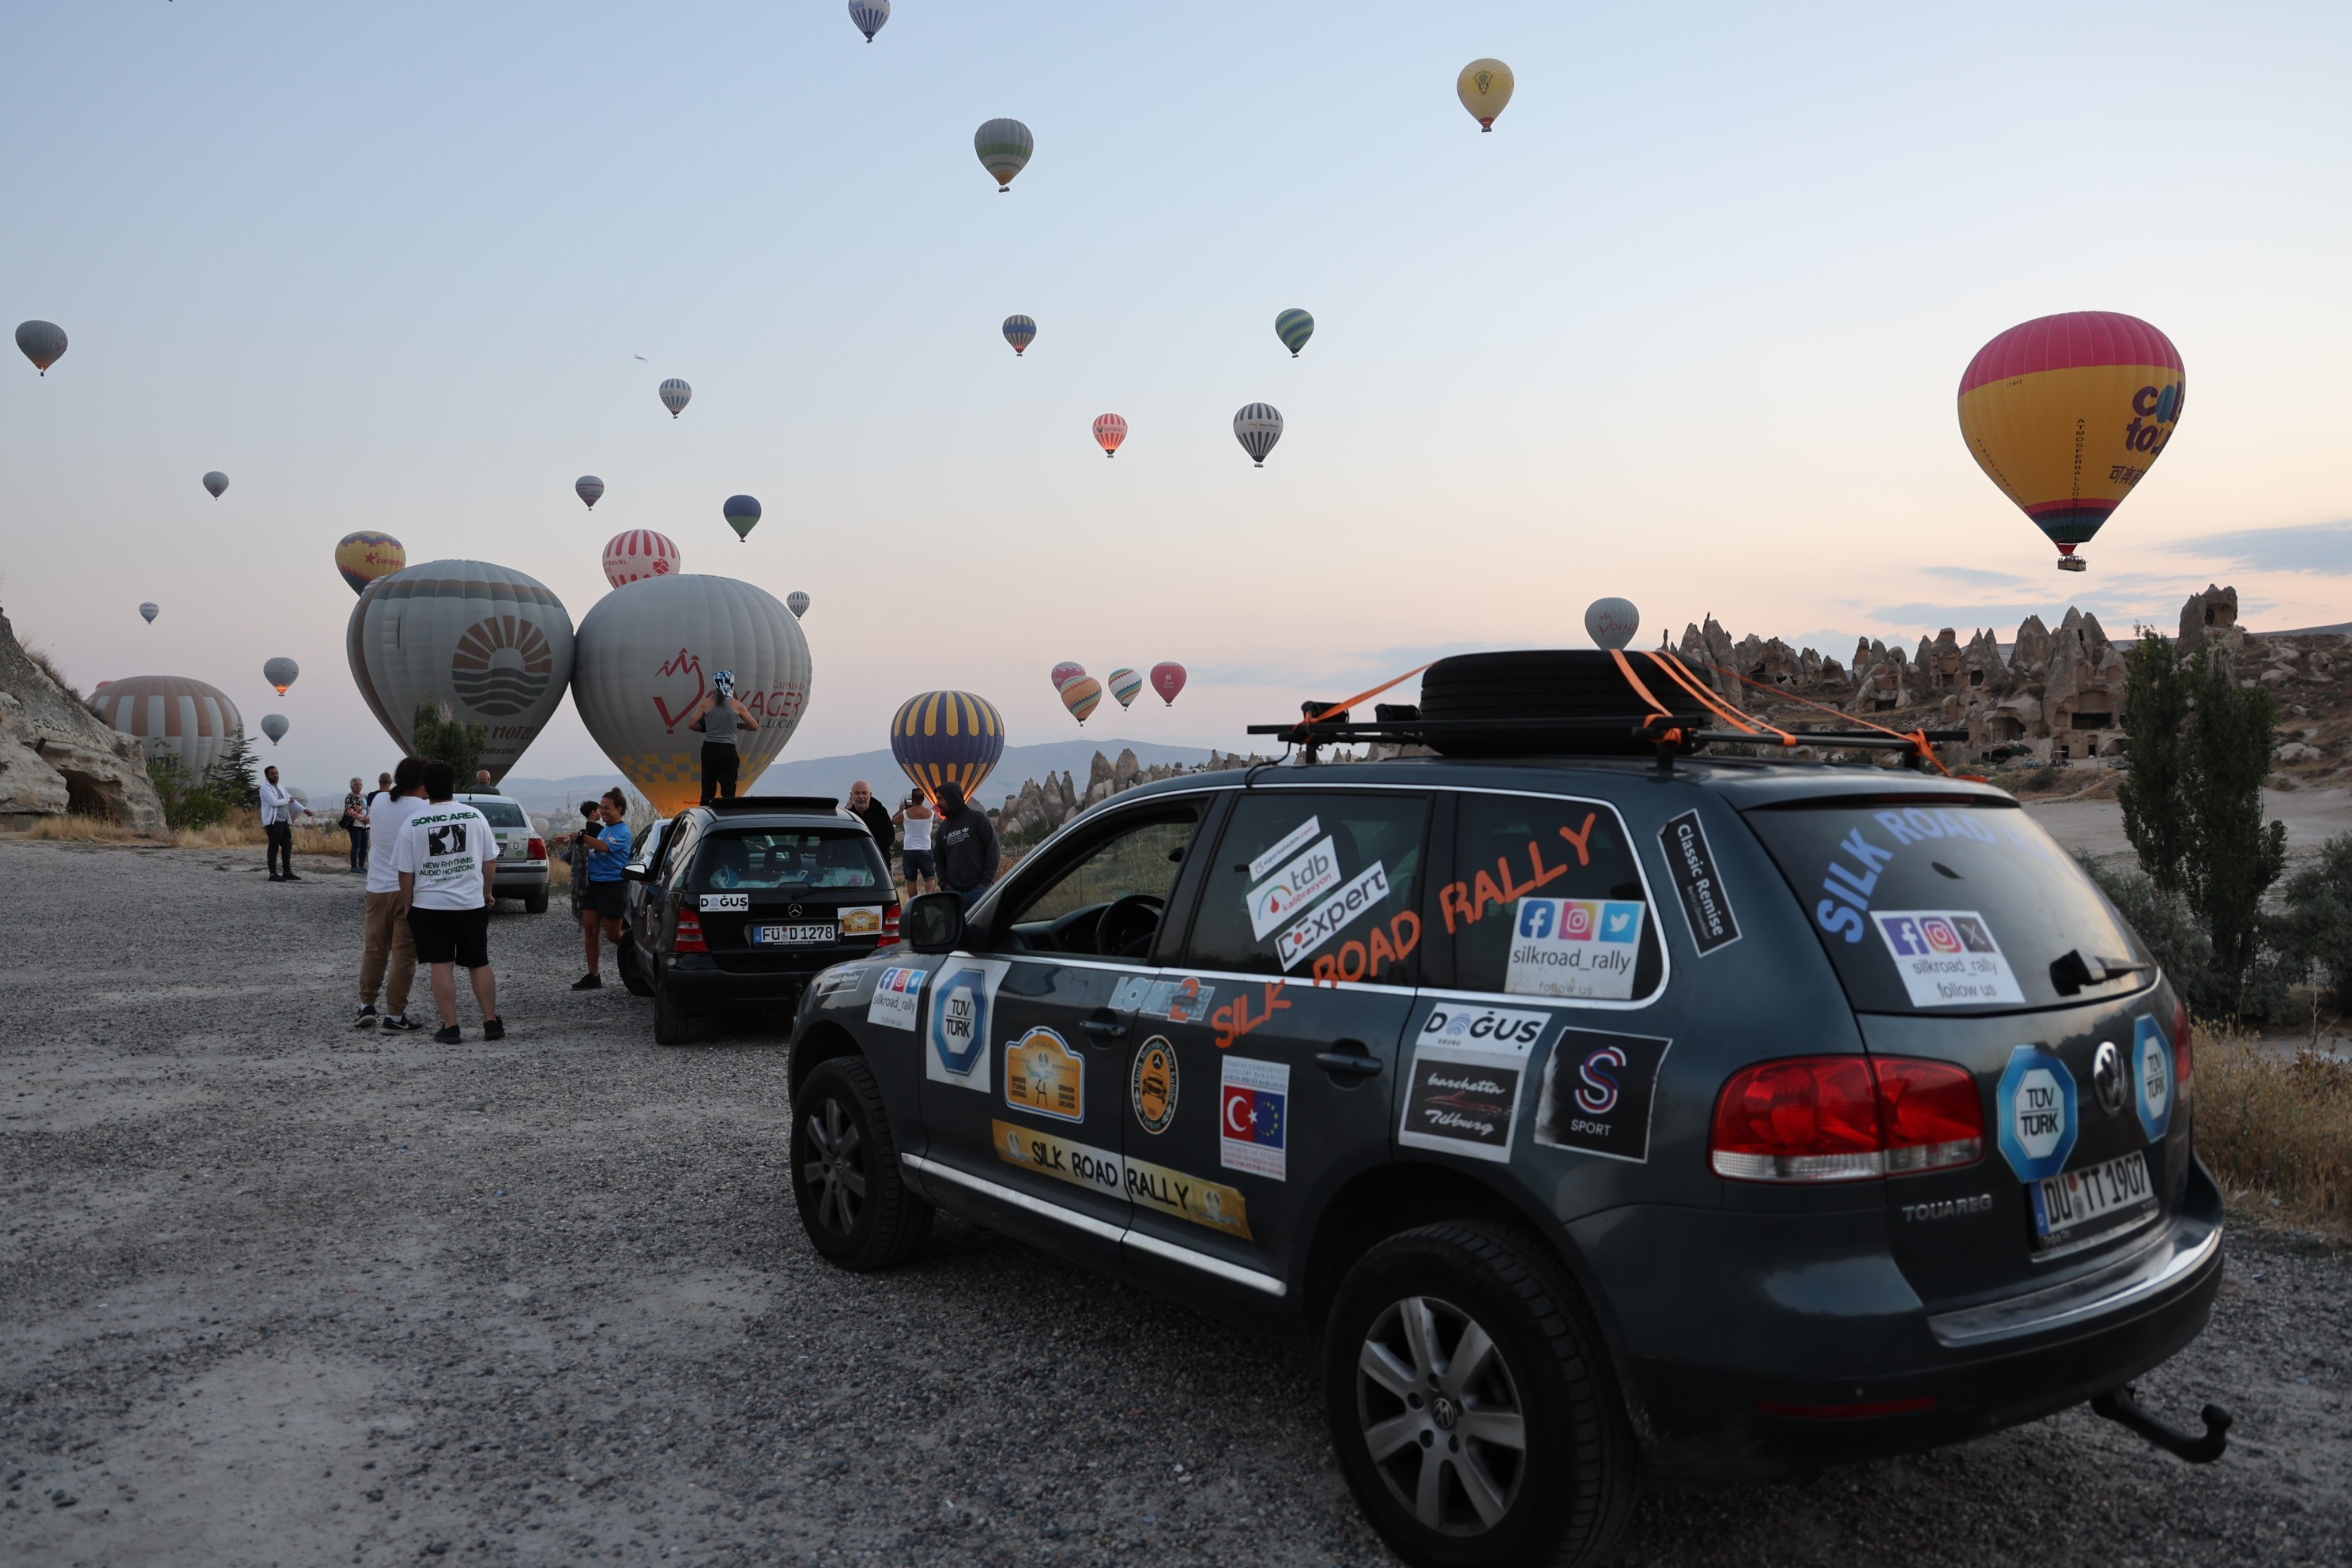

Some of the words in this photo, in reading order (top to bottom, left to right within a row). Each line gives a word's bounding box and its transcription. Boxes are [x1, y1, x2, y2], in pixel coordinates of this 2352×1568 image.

[412, 815, 447, 827] SONIC
[450, 812, 479, 821] AREA
[441, 857, 473, 868] RHYTHMS
[442, 864, 476, 876] HORIZONS
[1291, 854, 1329, 891] tdb
[1677, 823, 1704, 878] Classic
[1695, 877, 1724, 937] Remise
[1817, 827, 1894, 944] SILK
[1873, 806, 1997, 846] ROAD
[1282, 873, 1332, 912] kalibrasyon
[763, 928, 780, 940] FÜ
[789, 927, 797, 940] D
[801, 926, 833, 940] 1278
[1212, 979, 1292, 1048] SILK
[1313, 910, 1422, 989] ROAD
[1438, 812, 1596, 935] RALLY
[1512, 945, 1631, 974] silkroad_rally
[1539, 980, 1577, 996] follow
[1579, 986, 1593, 996] us
[1937, 982, 1977, 999] follow
[1981, 984, 1997, 997] us
[873, 993, 916, 1014] silkroad_rally
[952, 999, 971, 1019] TÜV
[1424, 1011, 1542, 1050] DOĞUŞ
[2147, 1051, 2162, 1073] TÜV
[1427, 1072, 1506, 1095] barchetta
[2146, 1075, 2166, 1099] TÜRK
[2026, 1087, 2054, 1108] TÜV
[1571, 1119, 1611, 1137] SPORT
[2020, 1112, 2060, 1136] TÜRK
[1031, 1140, 1066, 1171] SILK
[1072, 1152, 1118, 1188] ROAD
[1127, 1168, 1189, 1210] RALLY
[2079, 1166, 2105, 1212] TT
[2105, 1153, 2149, 1204] 1907
[1902, 1193, 1993, 1223] TOUAREG
